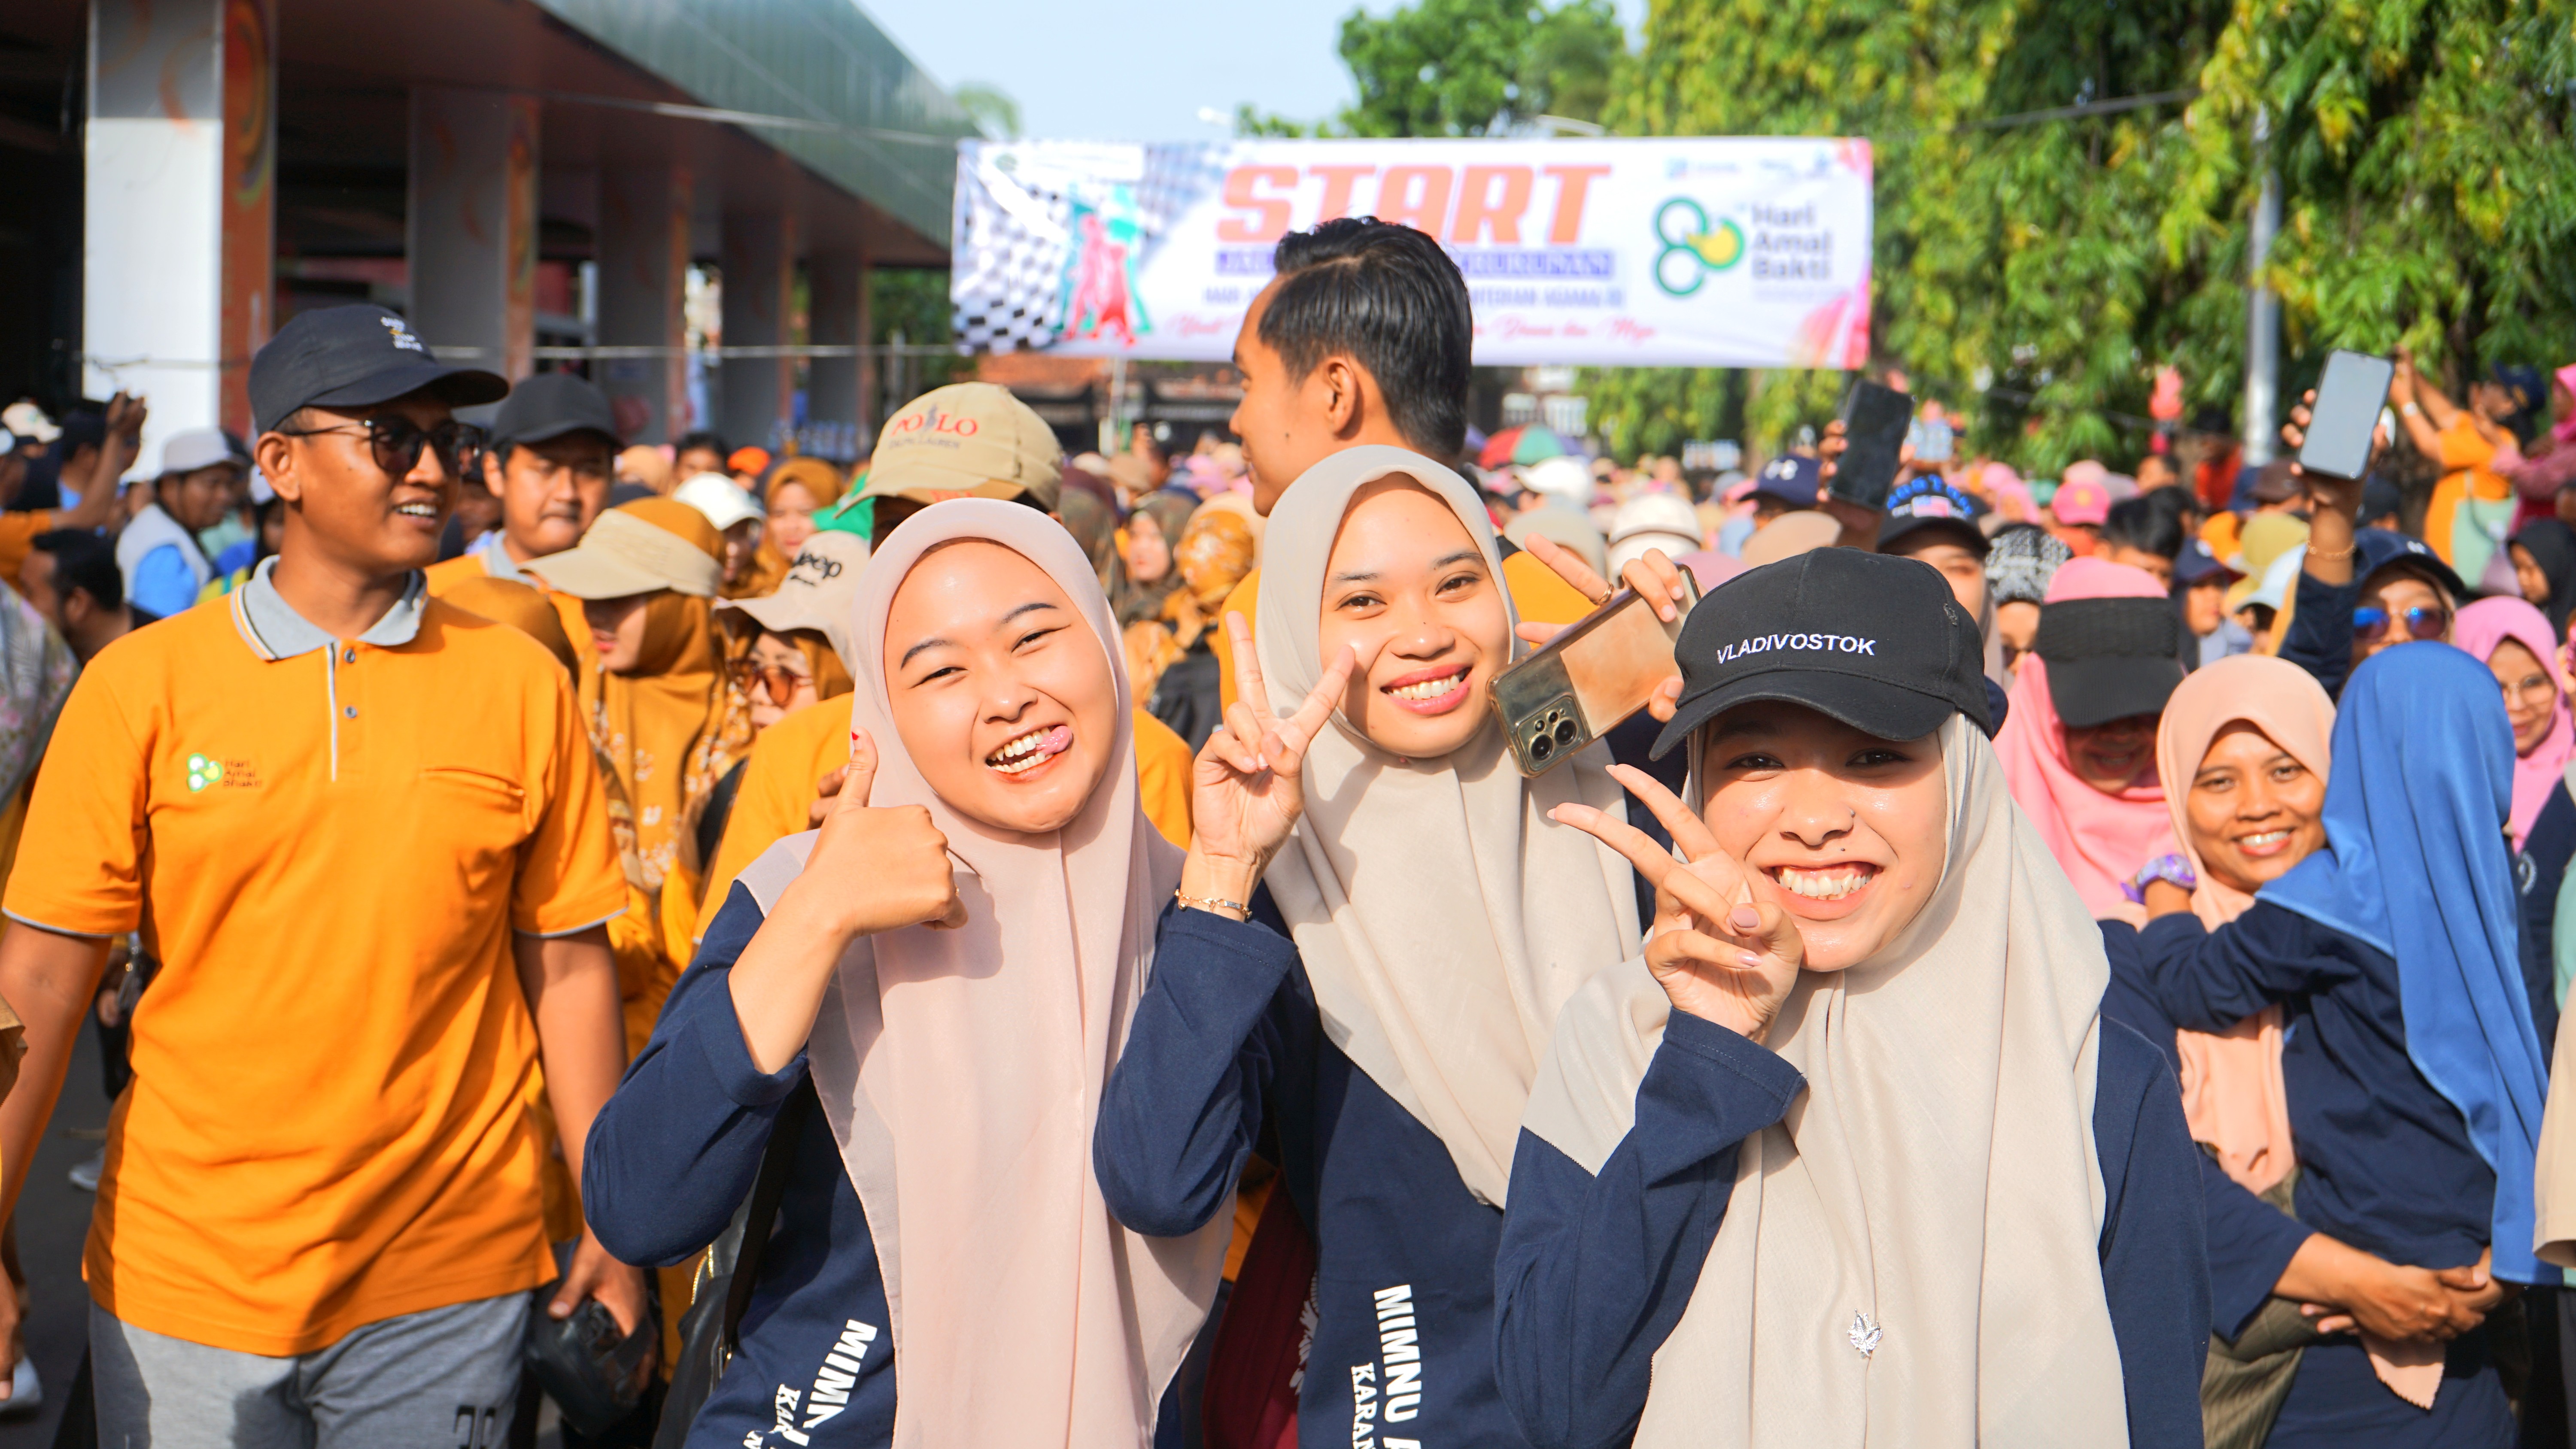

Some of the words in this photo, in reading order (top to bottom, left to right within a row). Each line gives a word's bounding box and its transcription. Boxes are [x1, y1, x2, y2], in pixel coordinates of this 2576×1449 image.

[1216, 165, 1611, 243] START
[1752, 203, 1815, 226] Hari
[1752, 230, 1831, 254] Amal
[1752, 257, 1830, 281] Bakti
[890, 415, 979, 437] POLO
[1717, 633, 1876, 664] VLADIVOSTOK
[1374, 1285, 1422, 1423] MIMNU
